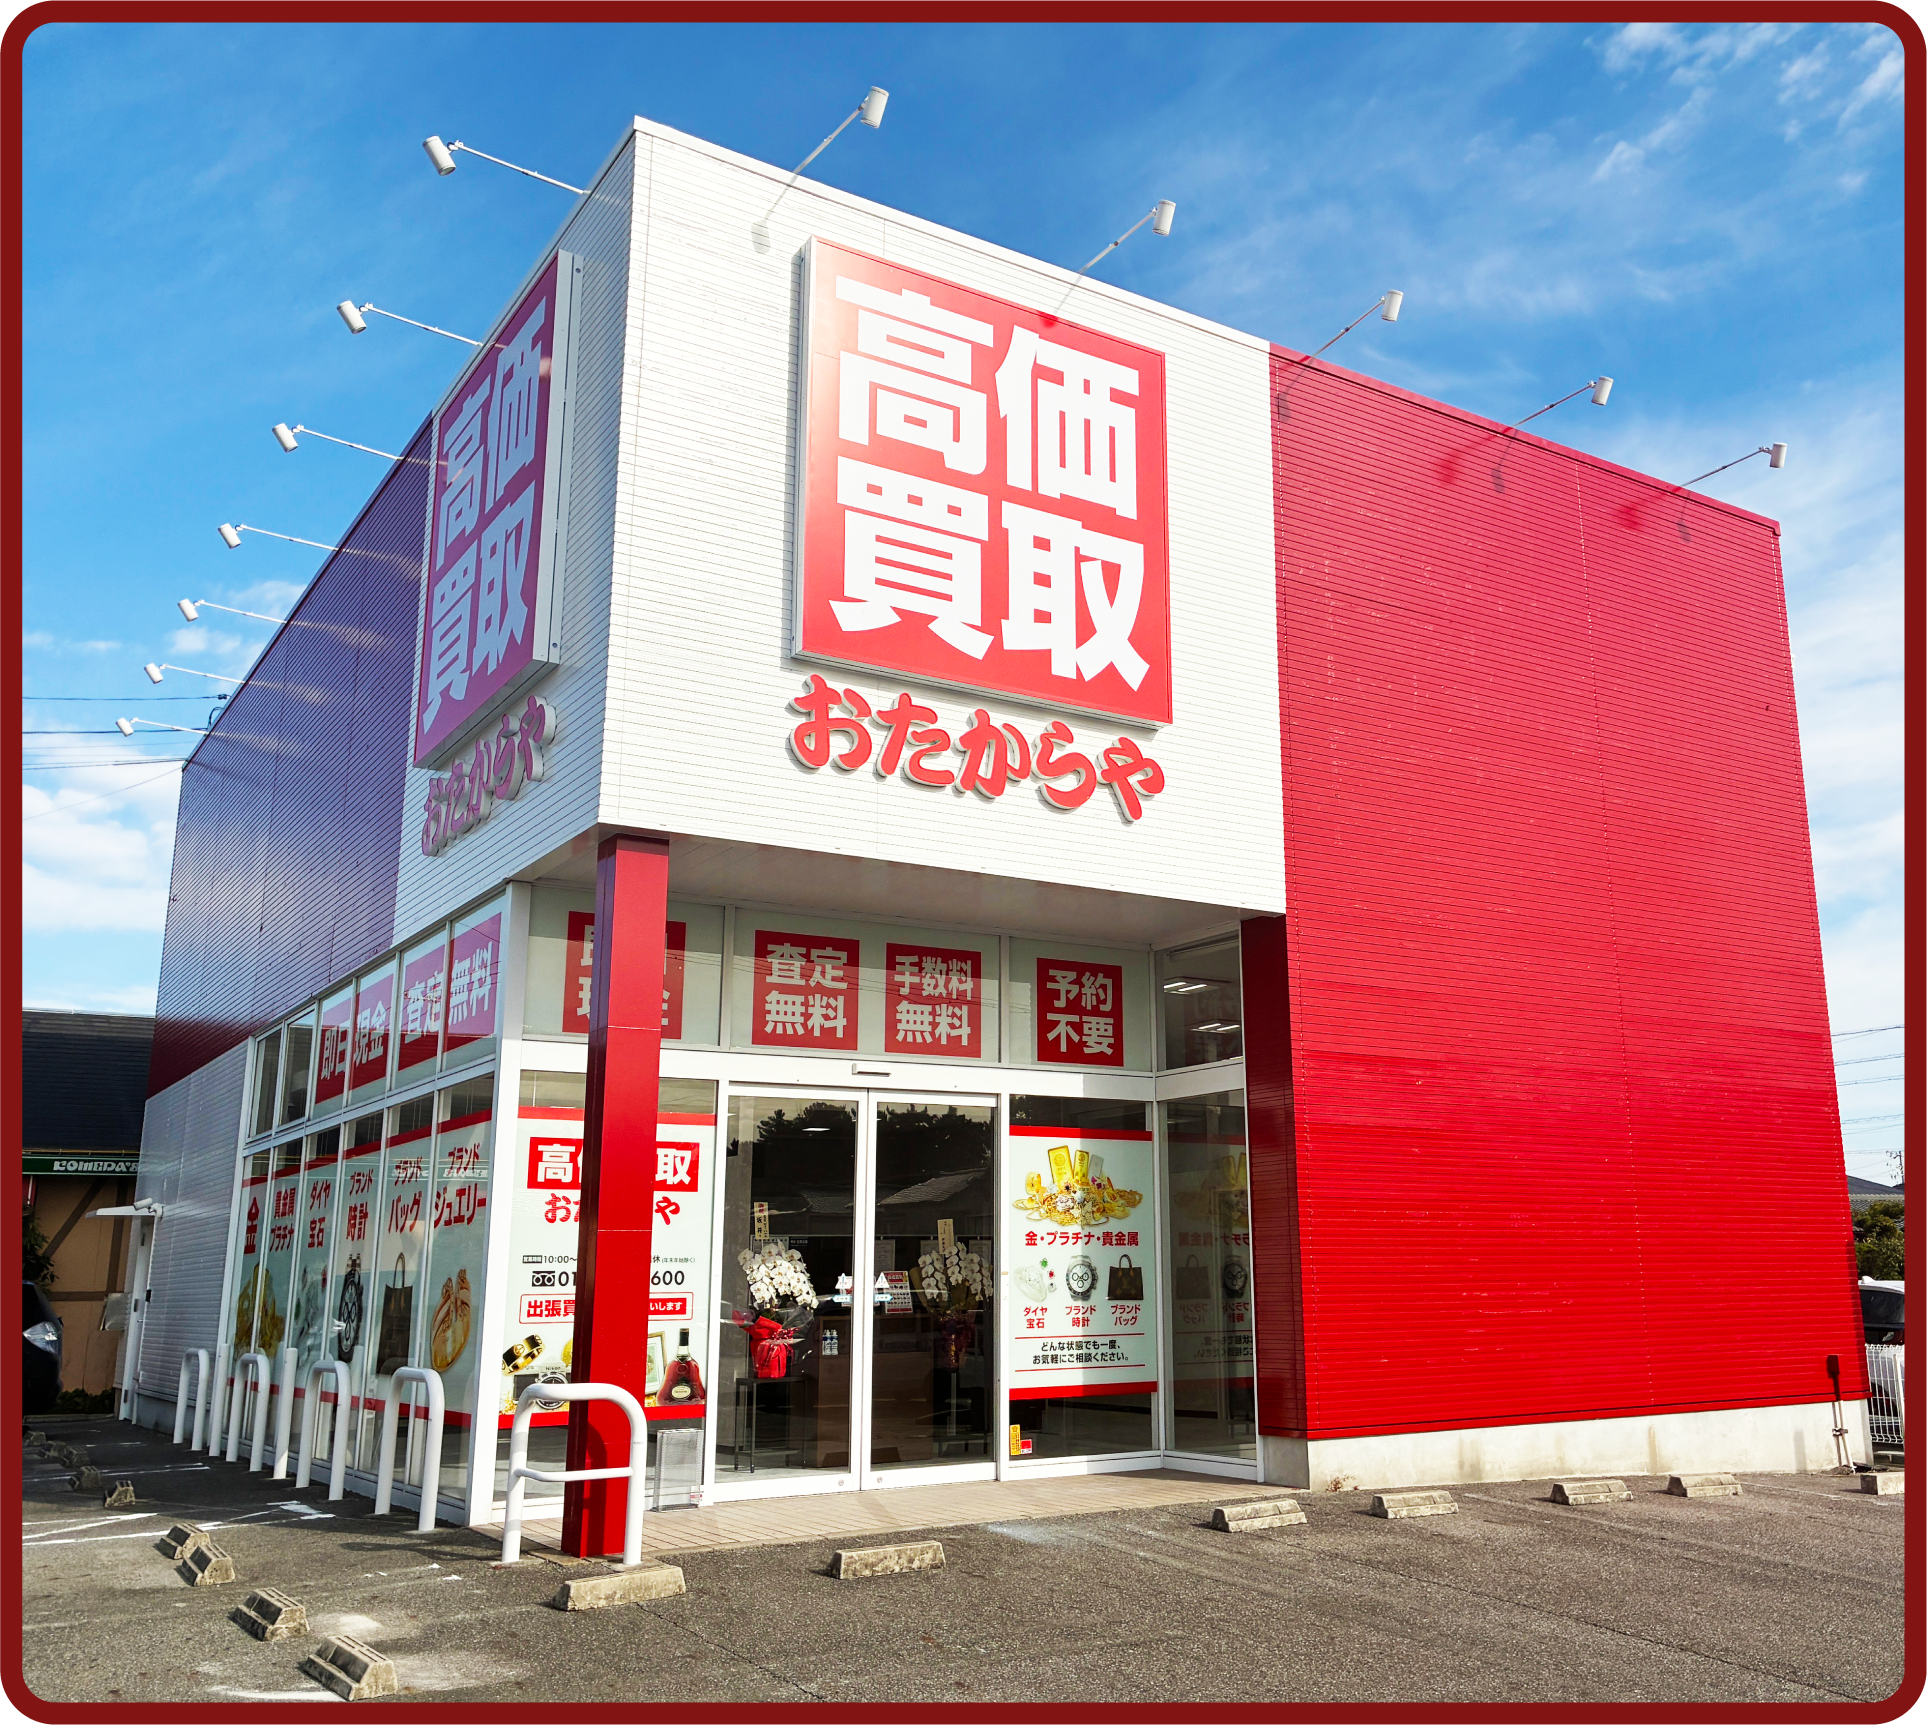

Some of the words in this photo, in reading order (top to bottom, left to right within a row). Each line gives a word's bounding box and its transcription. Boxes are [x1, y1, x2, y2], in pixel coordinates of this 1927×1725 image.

[836, 276, 1139, 520] 高価
[436, 295, 546, 571] 高価
[828, 455, 1150, 692] 買取
[423, 479, 536, 734] 買取
[790, 674, 1165, 822] おたからや
[422, 695, 549, 857] おたからや
[765, 943, 848, 991] 査定
[894, 955, 974, 1000] 手数料
[1046, 969, 1113, 1012] 予約
[764, 989, 848, 1037] 無料
[896, 1002, 972, 1046] 無料
[1046, 1012, 1115, 1056] 不要
[395, 1156, 422, 1187] ブランド
[447, 1143, 480, 1176] ブランド
[310, 1180, 331, 1211] ダイヤ
[349, 1169, 374, 1196] ブランド
[244, 1196, 260, 1254] 金
[346, 1201, 368, 1241] 時計
[388, 1190, 422, 1234] バッグ
[434, 1183, 487, 1229] ジュエリー
[269, 1223, 294, 1252] プラチナ
[308, 1217, 326, 1248] 宝石
[1025, 1231, 1139, 1246] 金・プラチナ・貴金属
[1023, 1306, 1048, 1317] ダイヤ
[1026, 1318, 1045, 1329] 宝石
[1065, 1305, 1096, 1316] ブランド
[1072, 1317, 1090, 1328] 時計
[1110, 1304, 1141, 1315] ブランド
[1114, 1316, 1138, 1327] バッグ
